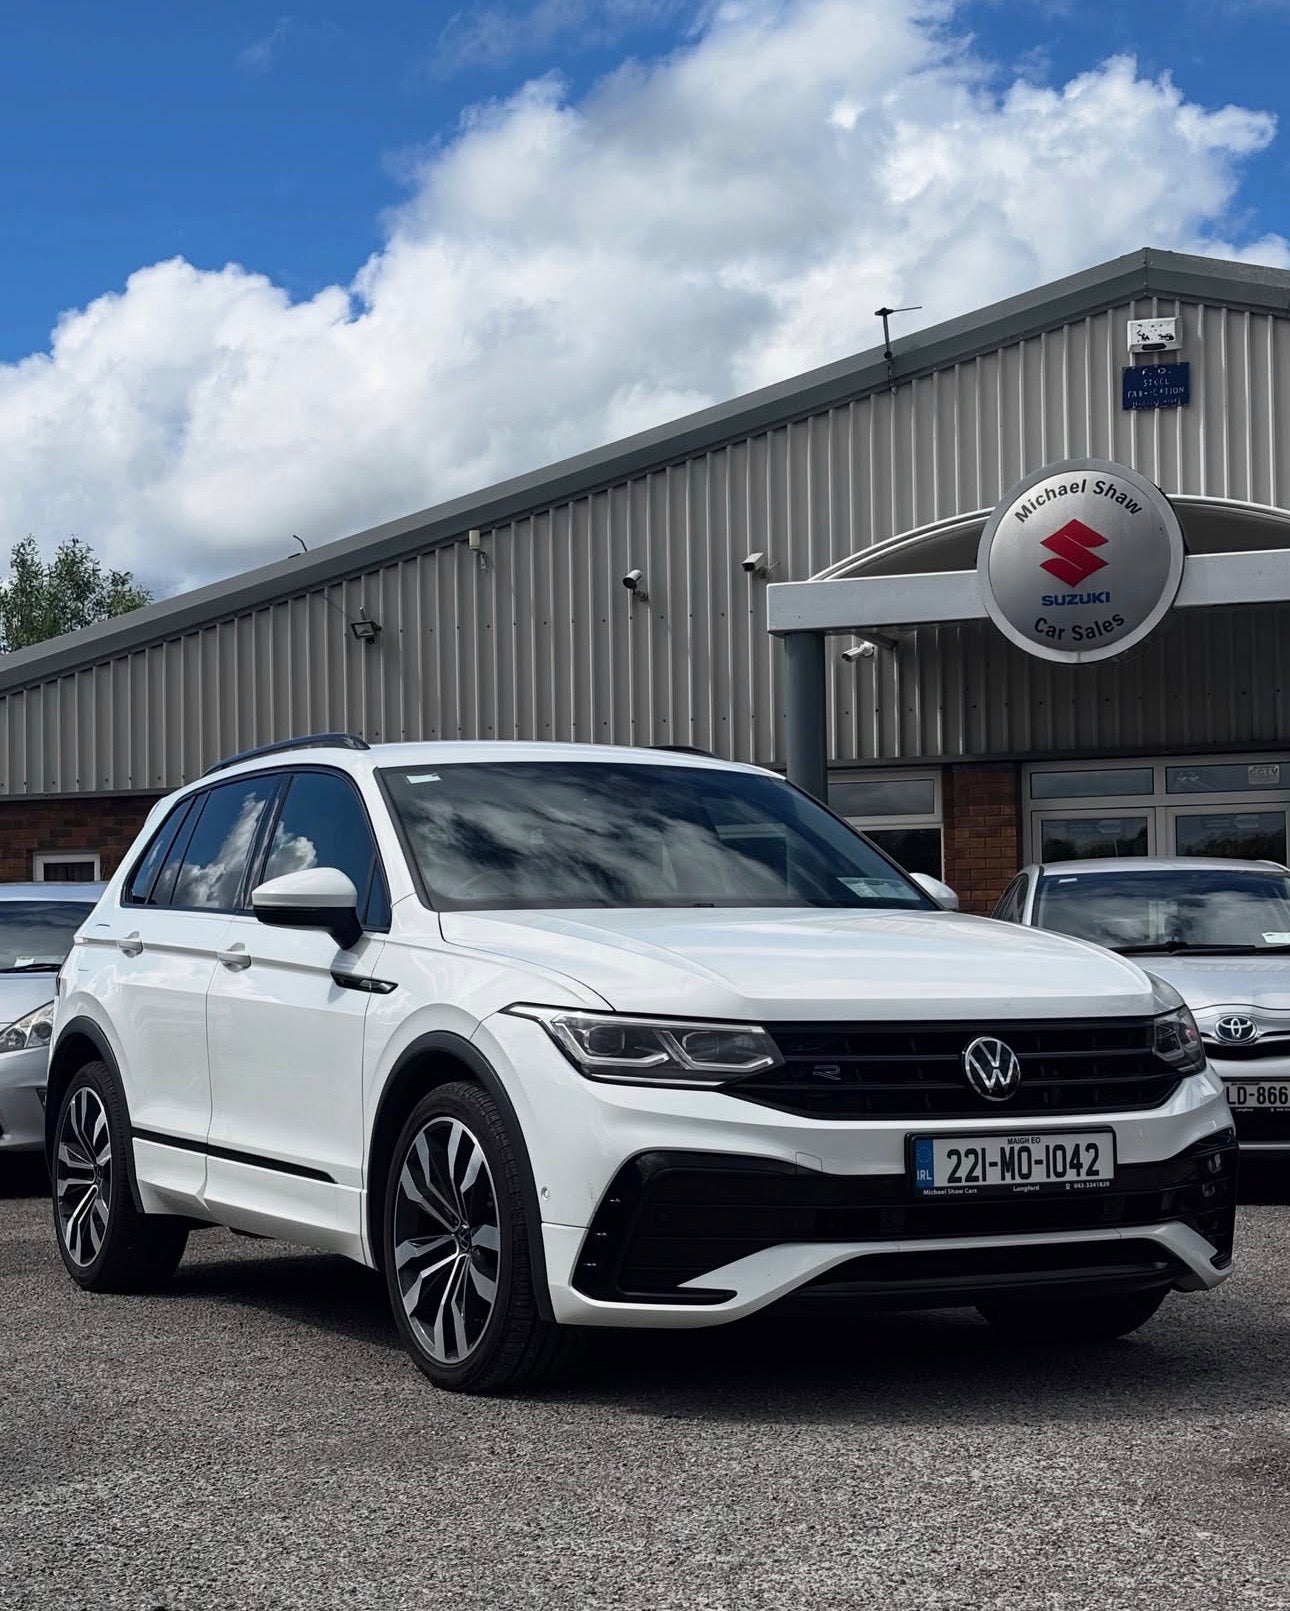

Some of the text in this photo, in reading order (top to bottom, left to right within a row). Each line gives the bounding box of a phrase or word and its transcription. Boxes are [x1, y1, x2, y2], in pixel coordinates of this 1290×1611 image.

[1014, 479, 1143, 523] Michael Shaw
[1041, 591, 1111, 607] SUZUKI
[1034, 613, 1125, 641] Car Sales
[1007, 1136, 1041, 1145] MAIGH EO
[946, 1142, 1100, 1184] 221-MO-1042
[916, 1169, 932, 1181] IRL
